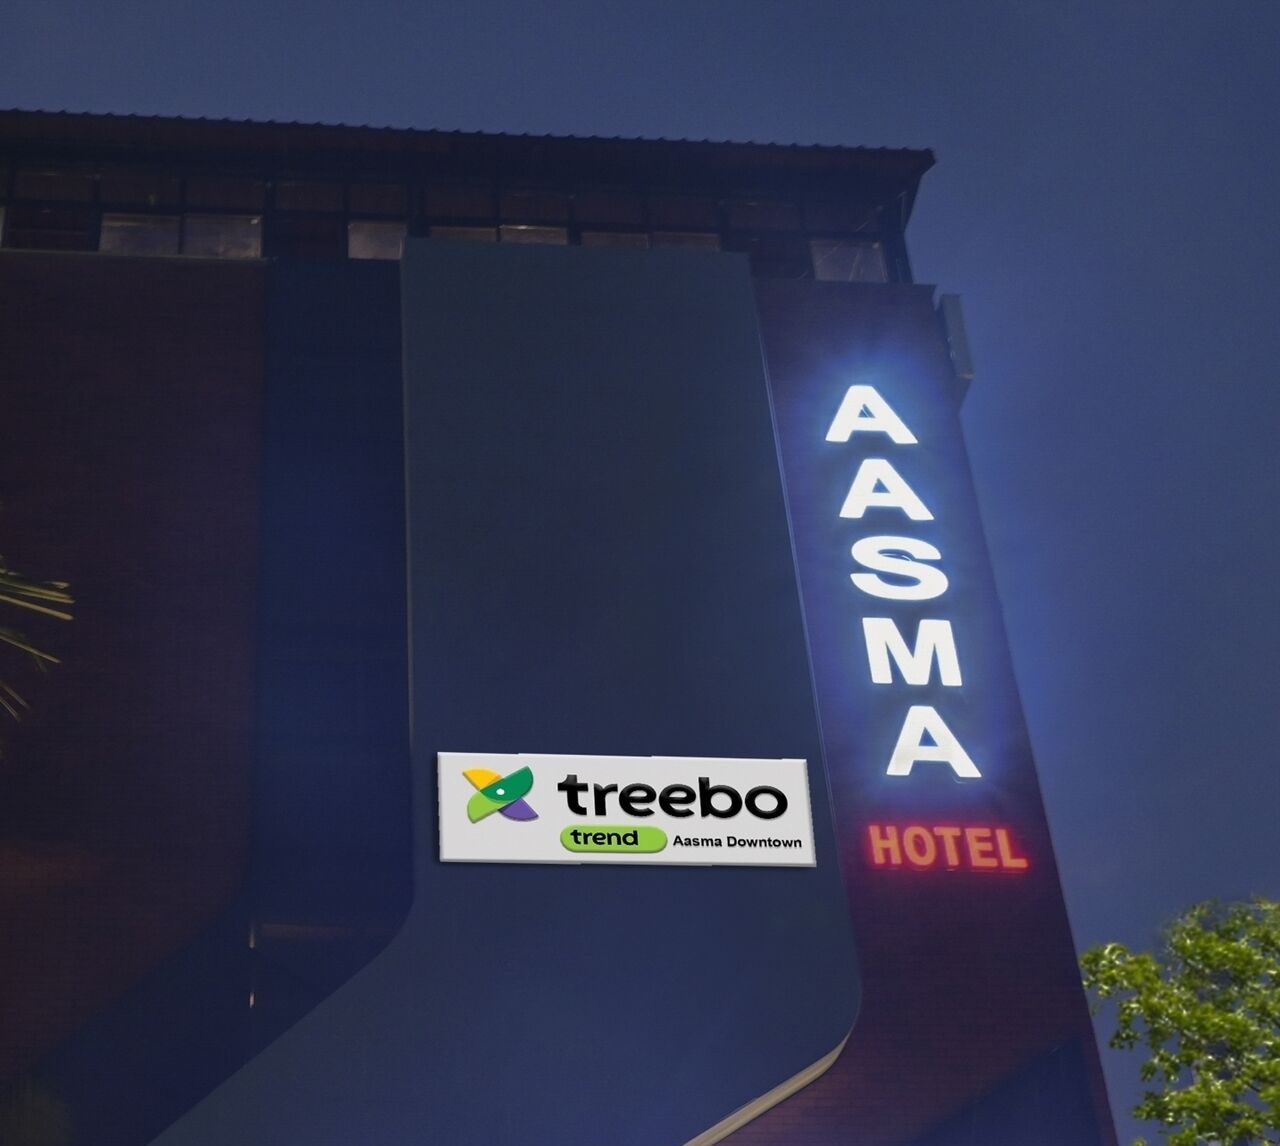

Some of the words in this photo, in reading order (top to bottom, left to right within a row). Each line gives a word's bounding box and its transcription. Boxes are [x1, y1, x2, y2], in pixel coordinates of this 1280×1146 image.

[825, 385, 983, 778] AASMA
[557, 774, 788, 819] treebo
[570, 829, 639, 846] trend
[672, 835, 723, 848] Aasma
[726, 836, 802, 848] Downtown
[868, 825, 1029, 869] HOTEL
